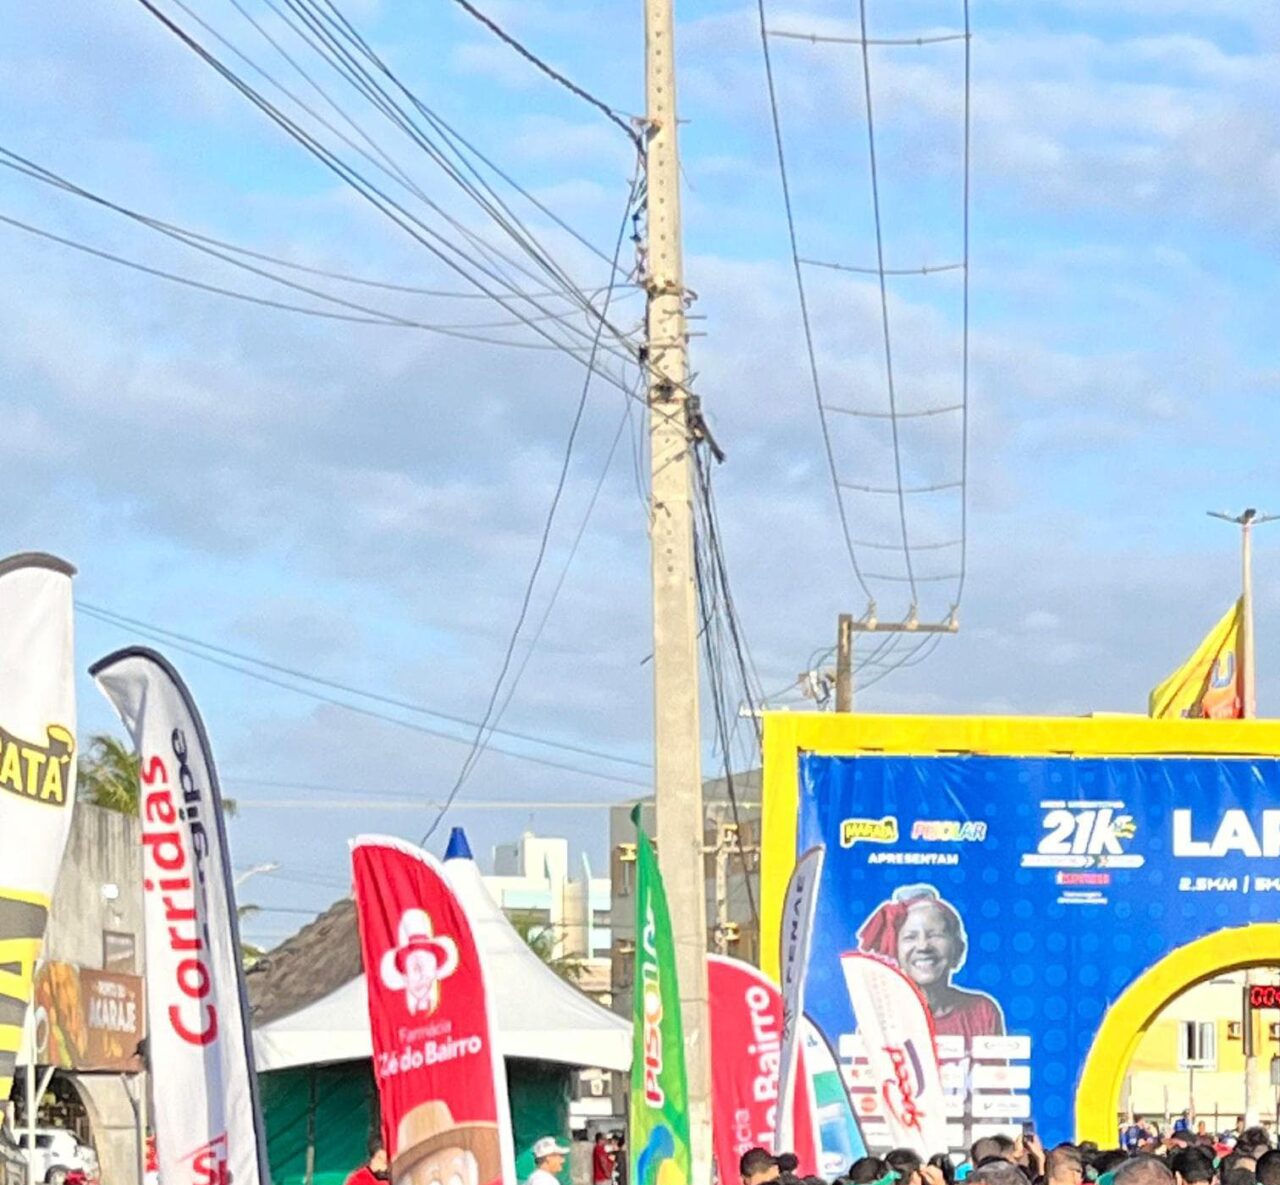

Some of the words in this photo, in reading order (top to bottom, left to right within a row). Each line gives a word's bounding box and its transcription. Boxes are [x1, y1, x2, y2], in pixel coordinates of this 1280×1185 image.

[0, 745, 70, 802] ATÁ
[867, 852, 960, 865] APRESENTAM
[141, 756, 218, 1047] Corridas
[400, 1045, 424, 1073] do
[424, 1034, 482, 1066] Bairro
[745, 985, 782, 1102] Bairro
